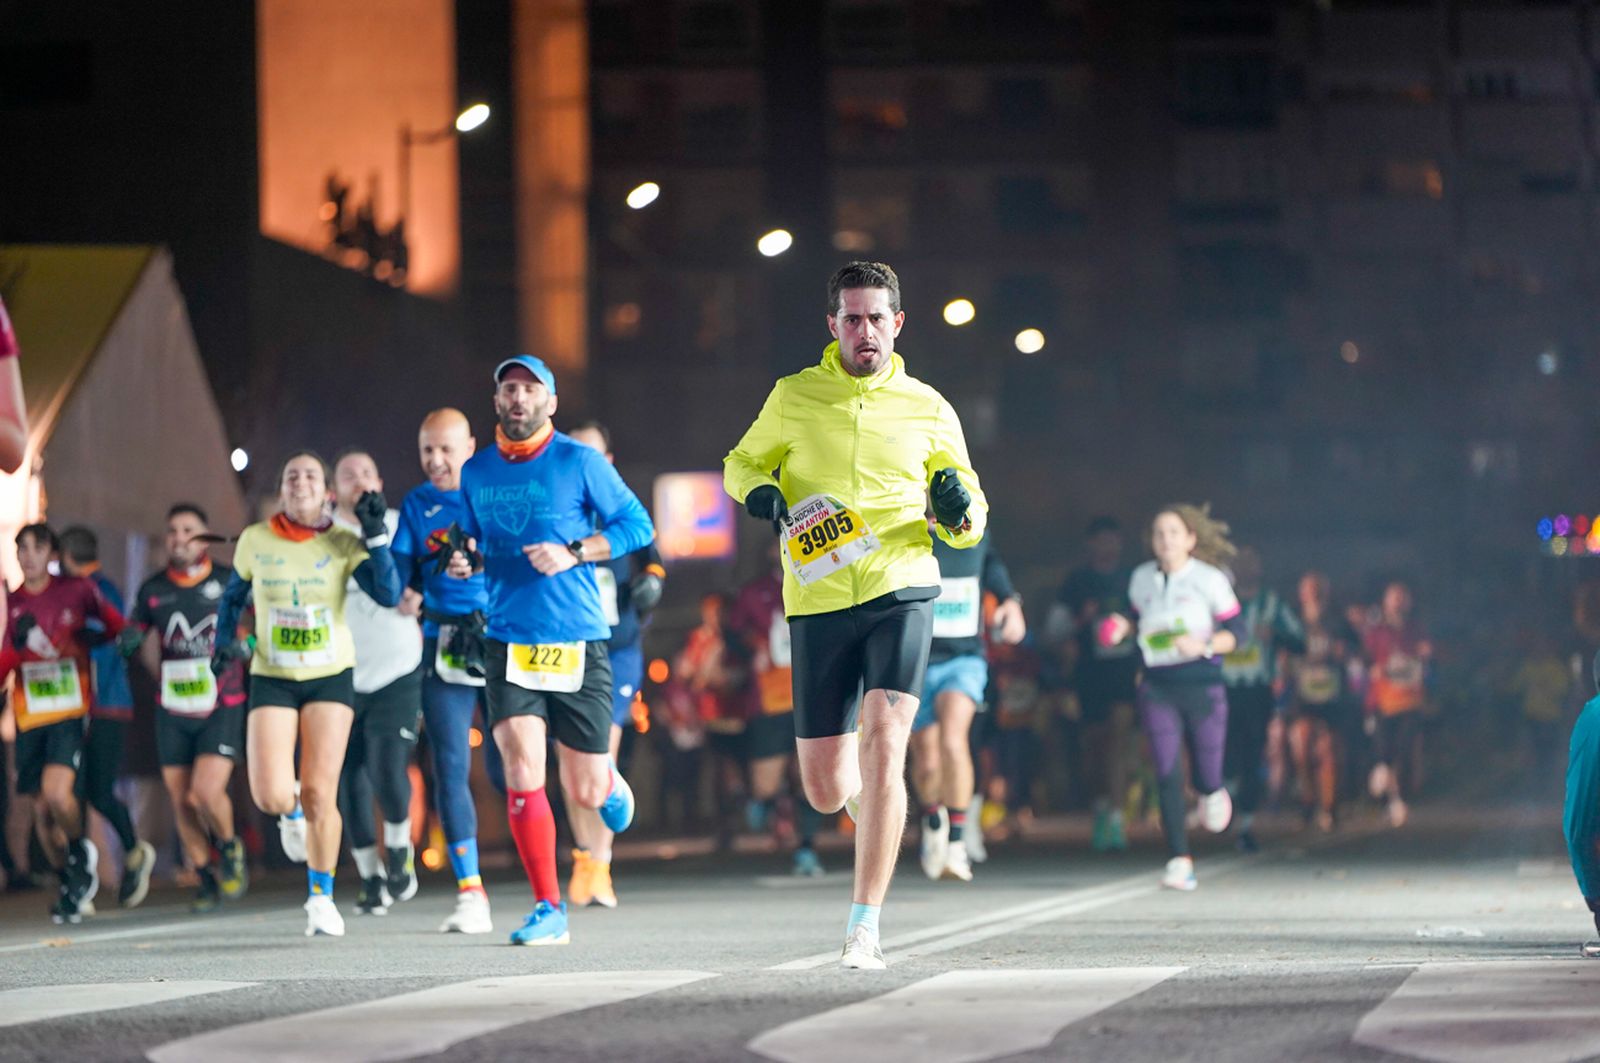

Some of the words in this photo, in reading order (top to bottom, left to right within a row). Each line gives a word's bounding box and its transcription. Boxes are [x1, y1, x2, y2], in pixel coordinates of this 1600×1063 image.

[794, 504, 816, 523] NOCHE
[815, 500, 825, 512] DE
[789, 522, 805, 538] SAN
[798, 510, 854, 556] 3905
[280, 627, 322, 646] 9265
[528, 644, 562, 667] 222
